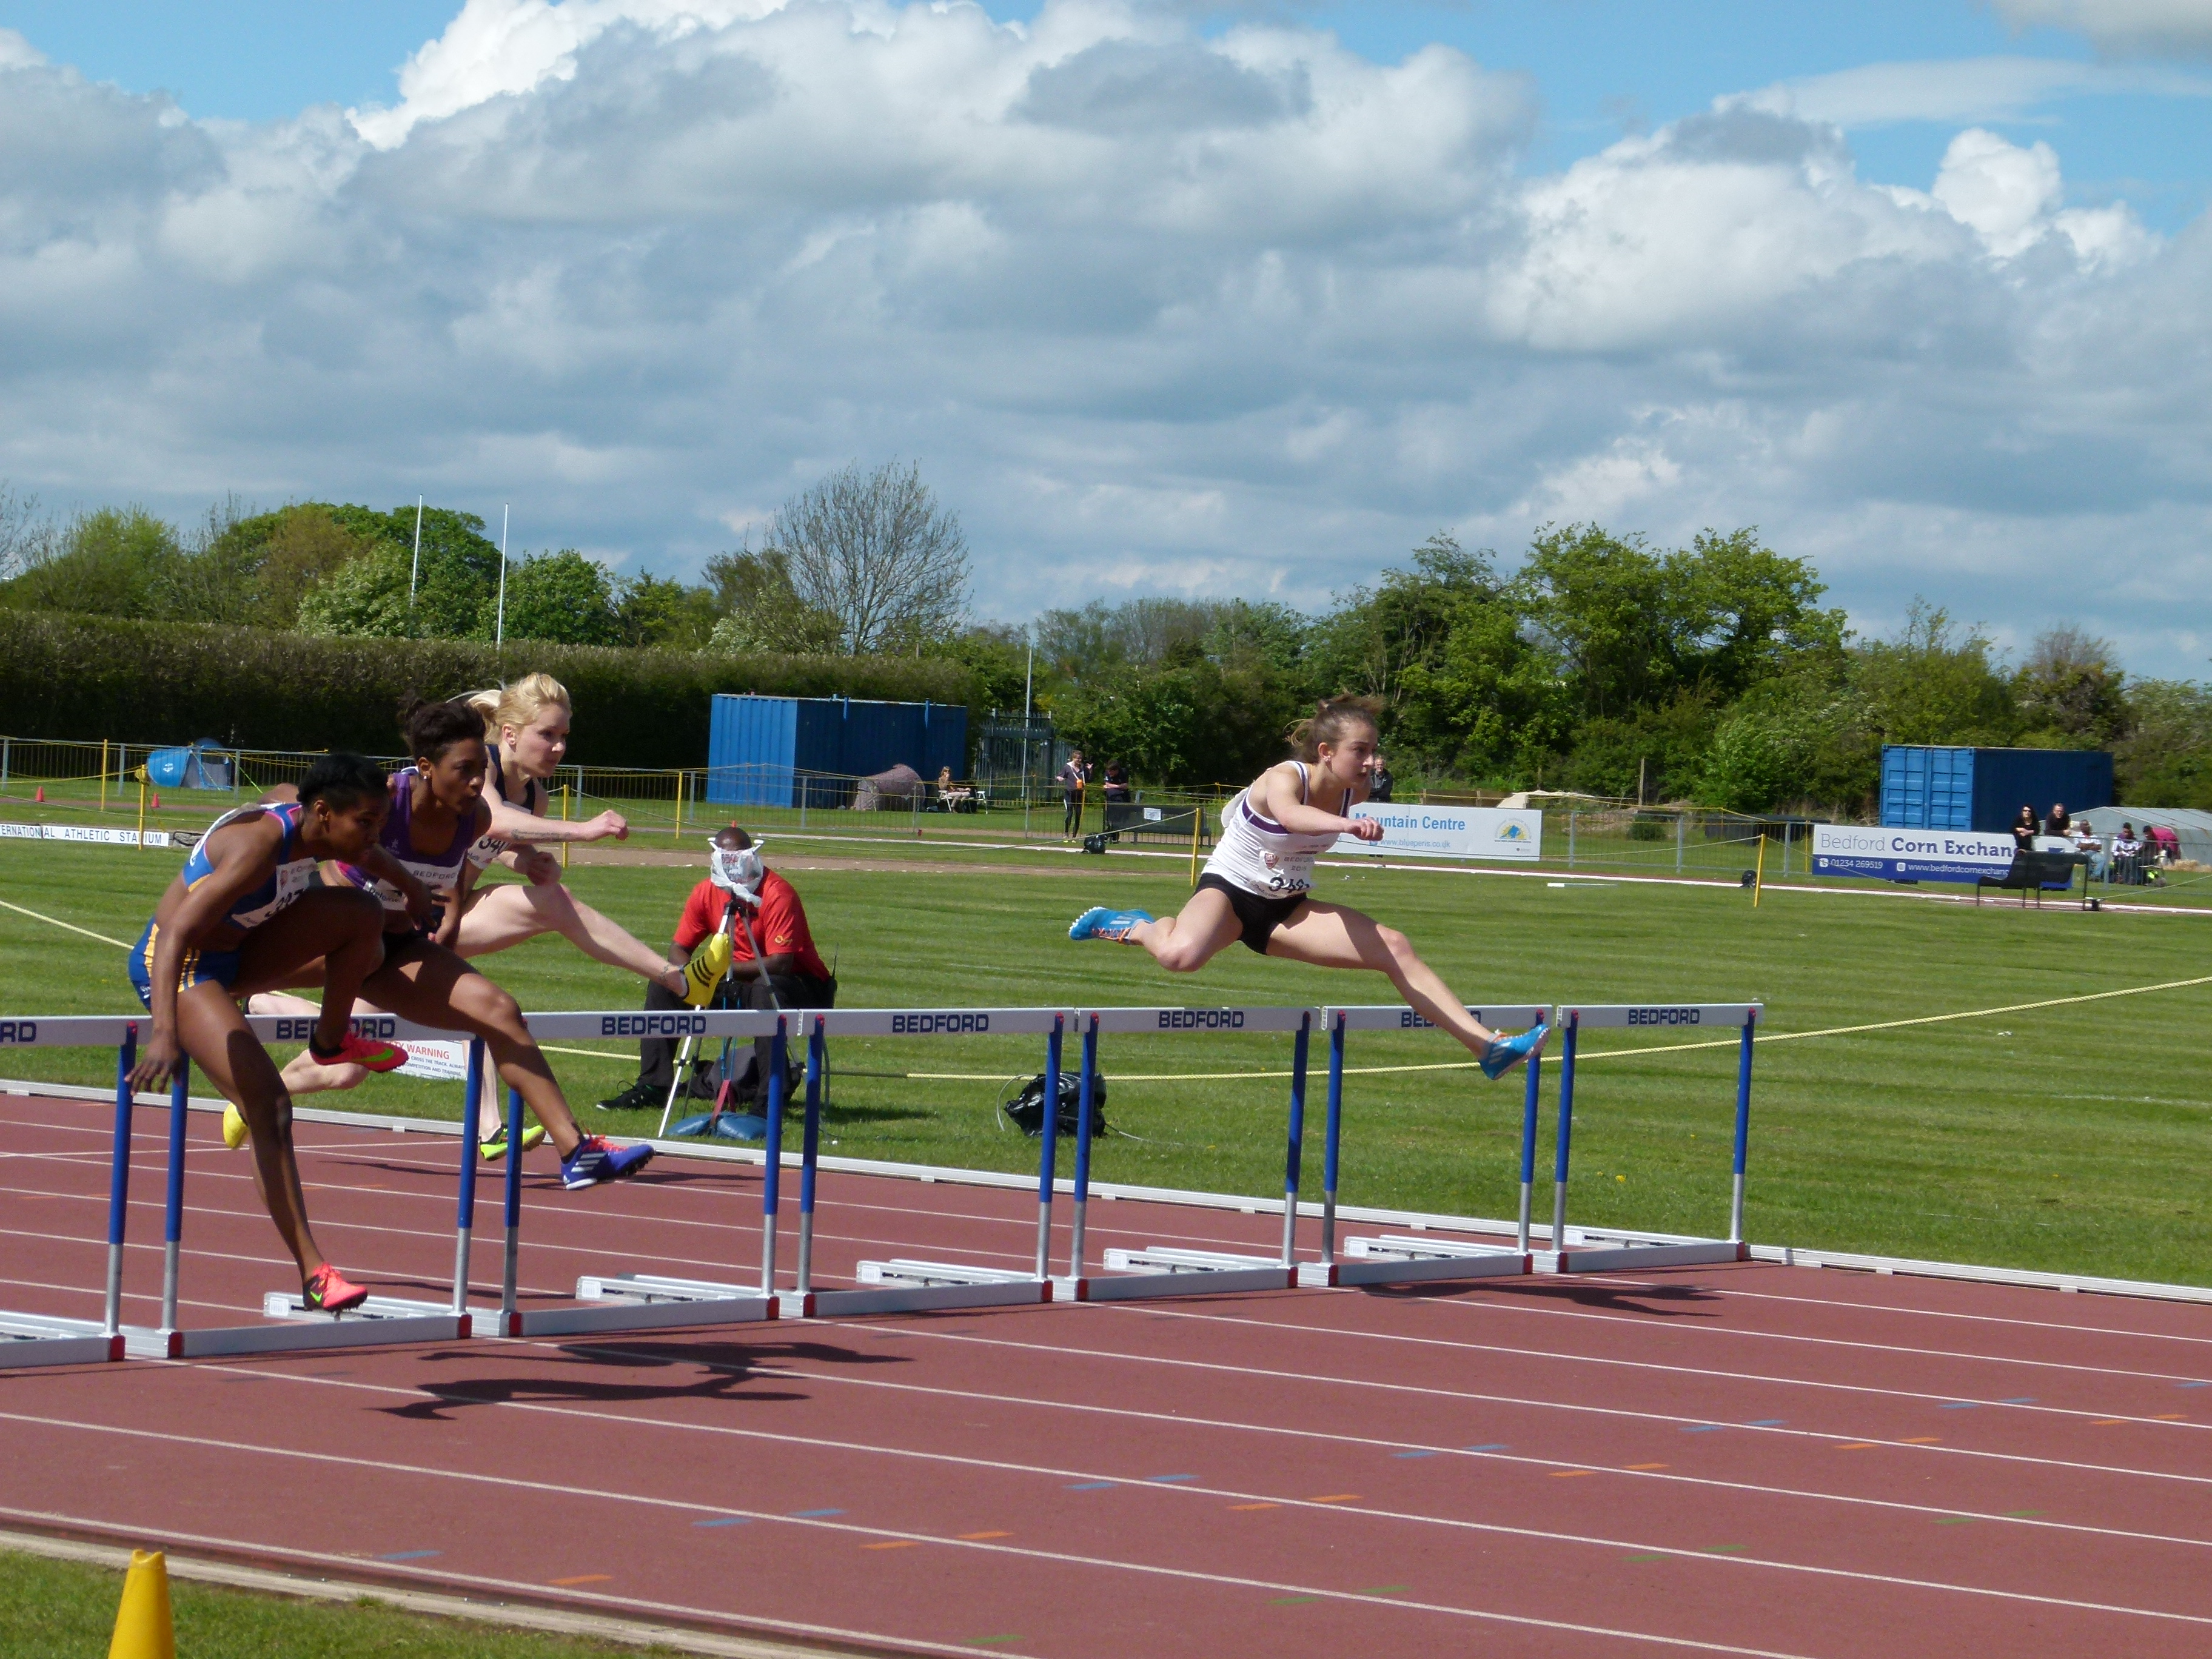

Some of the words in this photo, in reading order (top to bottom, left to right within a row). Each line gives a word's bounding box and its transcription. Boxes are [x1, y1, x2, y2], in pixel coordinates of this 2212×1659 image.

[1355, 813, 1418, 828] Muntain
[1422, 816, 1466, 831] Centre
[0, 825, 55, 837] ERNATIONAL
[64, 828, 110, 841] ATHLETIC
[119, 832, 162, 844] STAIUM
[1821, 833, 1885, 851] Bedford
[1891, 837, 1938, 853] Corn
[1945, 840, 2018, 857] Exchan
[1855, 860, 1883, 870] 269519
[602, 1015, 706, 1036] BEDFORD
[892, 1014, 988, 1033] BEDFORD
[1158, 1010, 1244, 1028] BEDFORD
[1628, 1008, 1700, 1025] BEDFORD
[407, 1044, 450, 1060] WARNING
